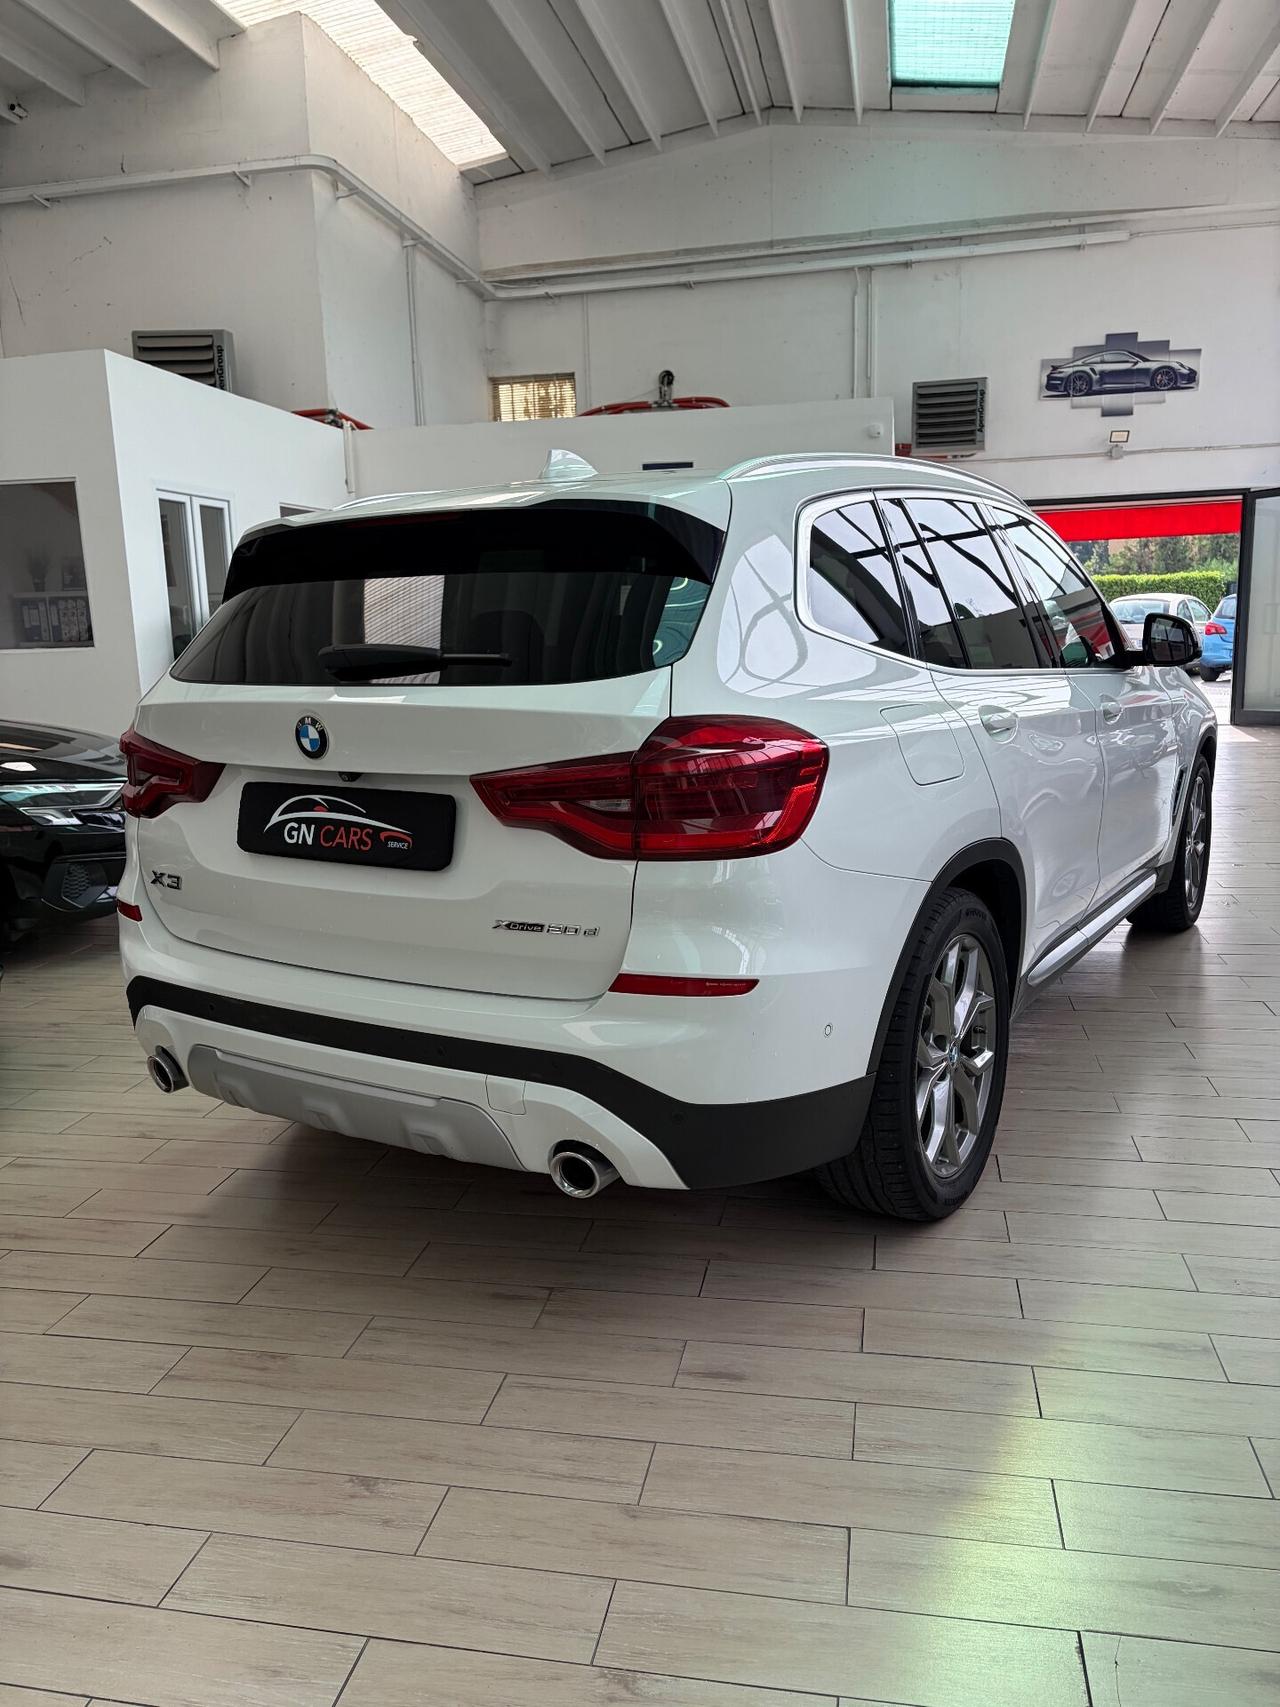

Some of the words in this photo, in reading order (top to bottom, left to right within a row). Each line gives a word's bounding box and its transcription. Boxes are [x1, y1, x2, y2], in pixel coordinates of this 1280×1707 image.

[977, 389, 986, 433] ApenGroup
[297, 717, 323, 731] BMW
[284, 822, 315, 845] GN
[320, 825, 373, 851] CARS
[387, 841, 409, 850] SERVICE
[151, 870, 182, 890] X3
